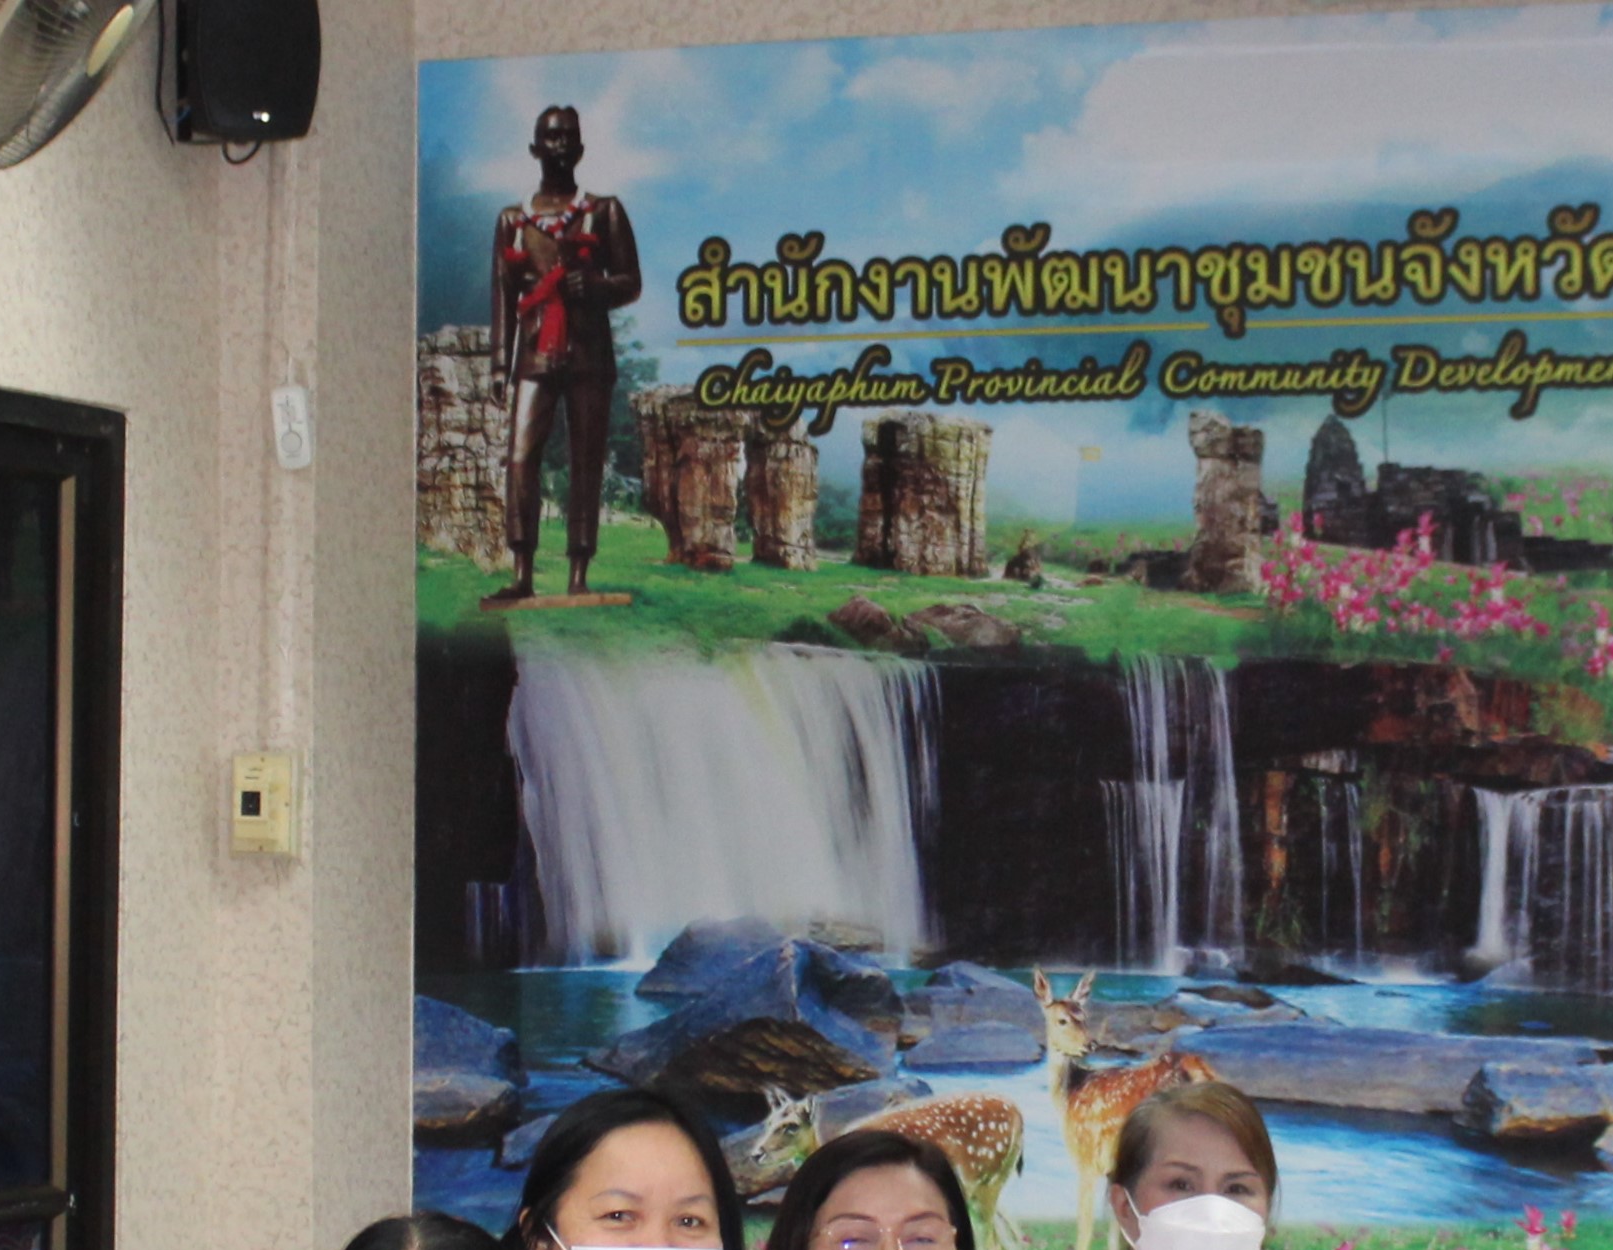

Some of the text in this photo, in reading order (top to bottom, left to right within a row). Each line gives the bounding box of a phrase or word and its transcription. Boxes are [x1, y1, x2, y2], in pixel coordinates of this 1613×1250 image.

[699, 347, 926, 434] Chaiyaphum
[934, 342, 1151, 400] Provincial
[1164, 350, 1384, 416] Community
